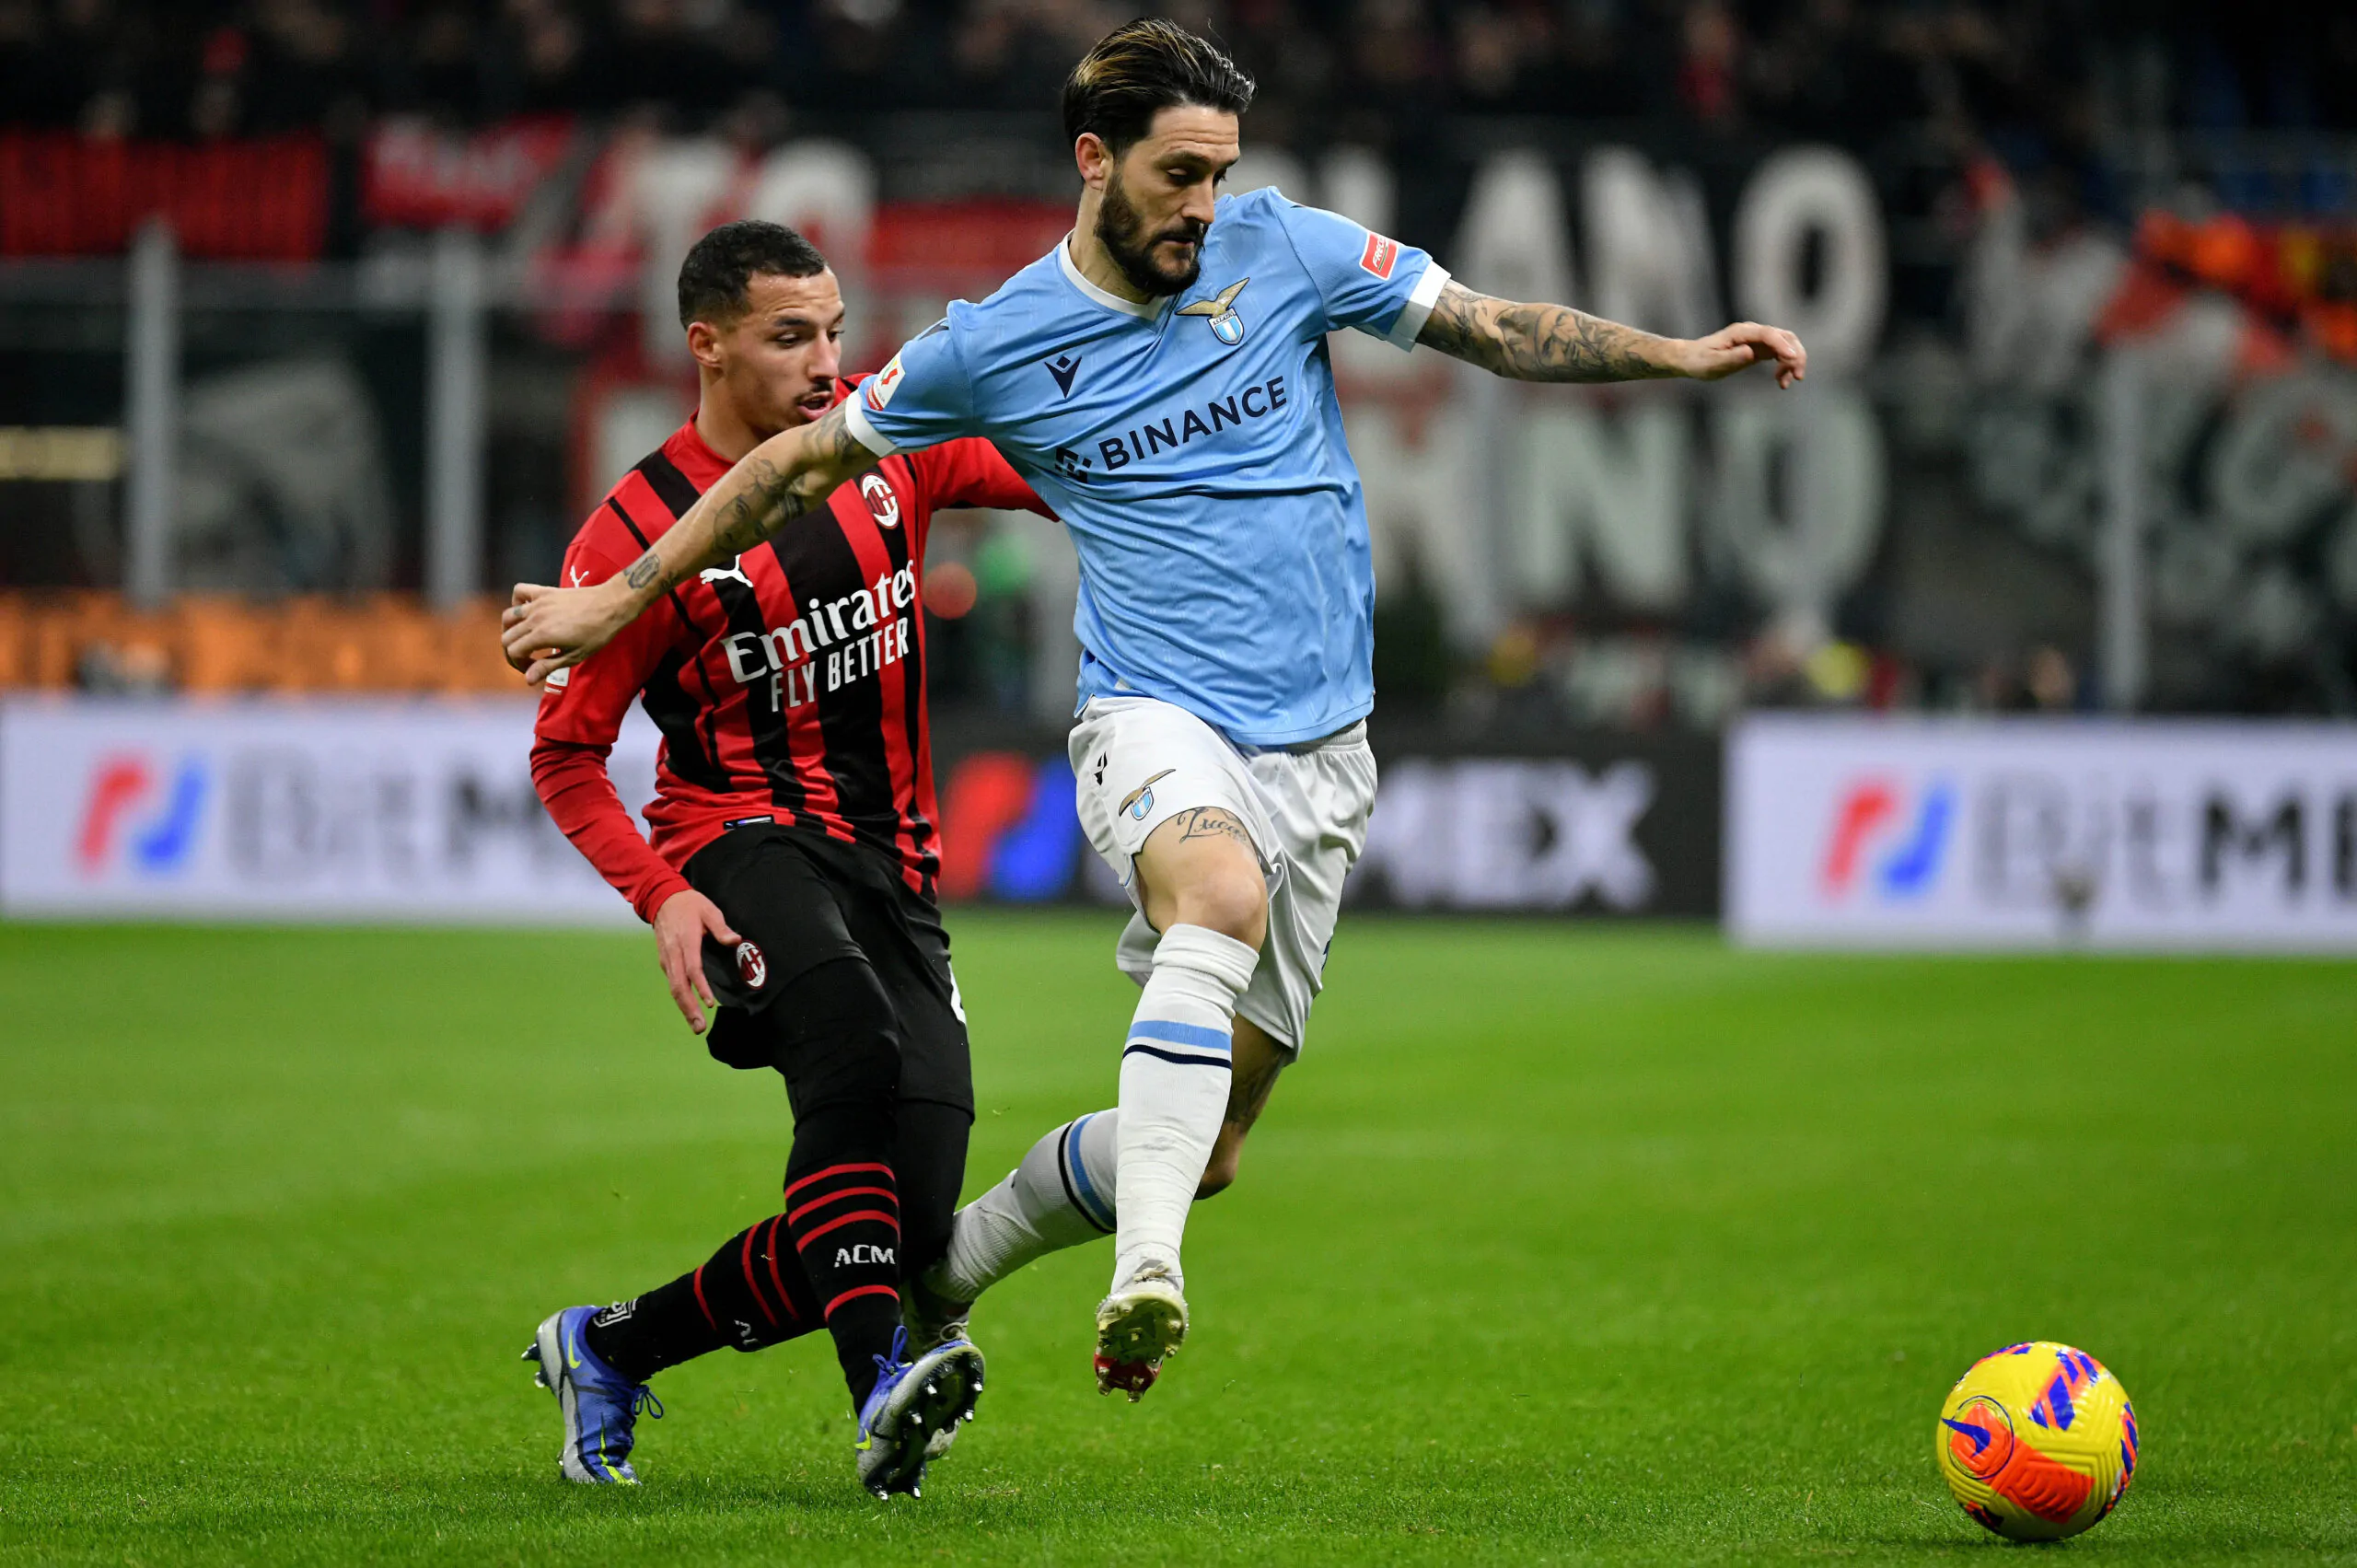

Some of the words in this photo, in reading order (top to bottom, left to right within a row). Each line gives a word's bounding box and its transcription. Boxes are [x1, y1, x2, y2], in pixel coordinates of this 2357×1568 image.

[1098, 376, 1287, 471] BINANCE
[721, 560, 916, 683] Emirates
[771, 661, 817, 713] FLY
[828, 617, 910, 692] BETTER
[833, 1244, 896, 1268] ACM
